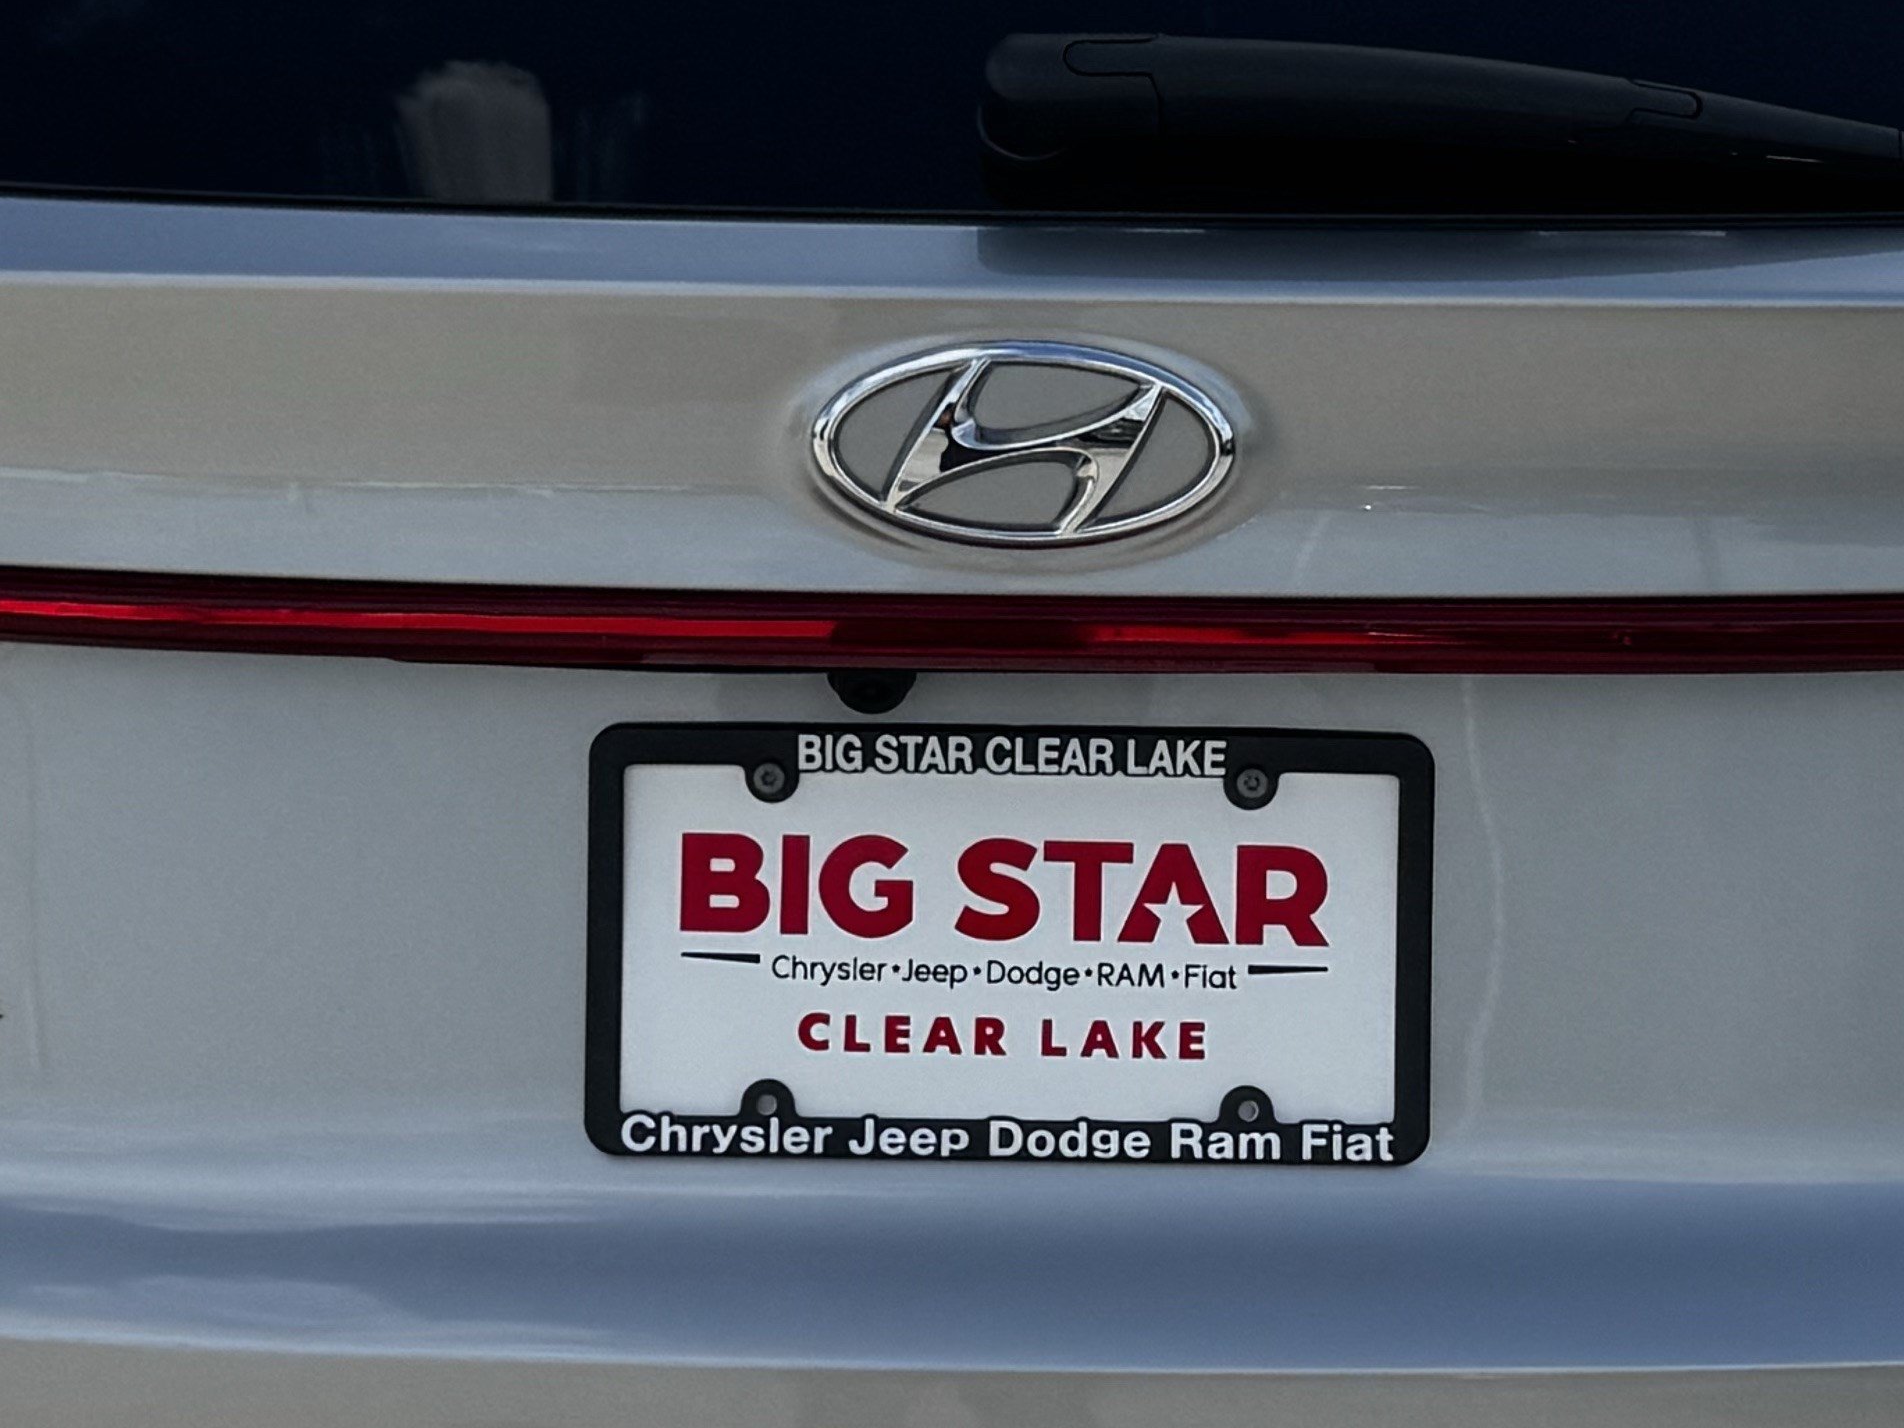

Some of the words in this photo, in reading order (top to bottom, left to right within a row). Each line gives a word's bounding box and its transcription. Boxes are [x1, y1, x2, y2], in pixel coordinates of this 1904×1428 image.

[797, 733, 863, 772] BIG
[874, 734, 973, 773] STAR
[985, 735, 1115, 775] CLEAR
[1127, 738, 1228, 777] LAKE
[679, 832, 914, 939] BIG
[954, 837, 1330, 947] STAR
[771, 954, 887, 987] Chrysler
[901, 958, 969, 990] Jeep
[985, 959, 1081, 992] Dodge
[1096, 962, 1165, 988] RAM
[1184, 963, 1238, 990] Fiat
[797, 1012, 1007, 1057] CLEAR
[1040, 1018, 1206, 1060] LAKE
[620, 1114, 834, 1154] Chrysler
[847, 1117, 970, 1158] Jeep
[988, 1120, 1152, 1160] Dodge
[1170, 1122, 1282, 1161] Ram
[1301, 1124, 1395, 1162] Fiat
